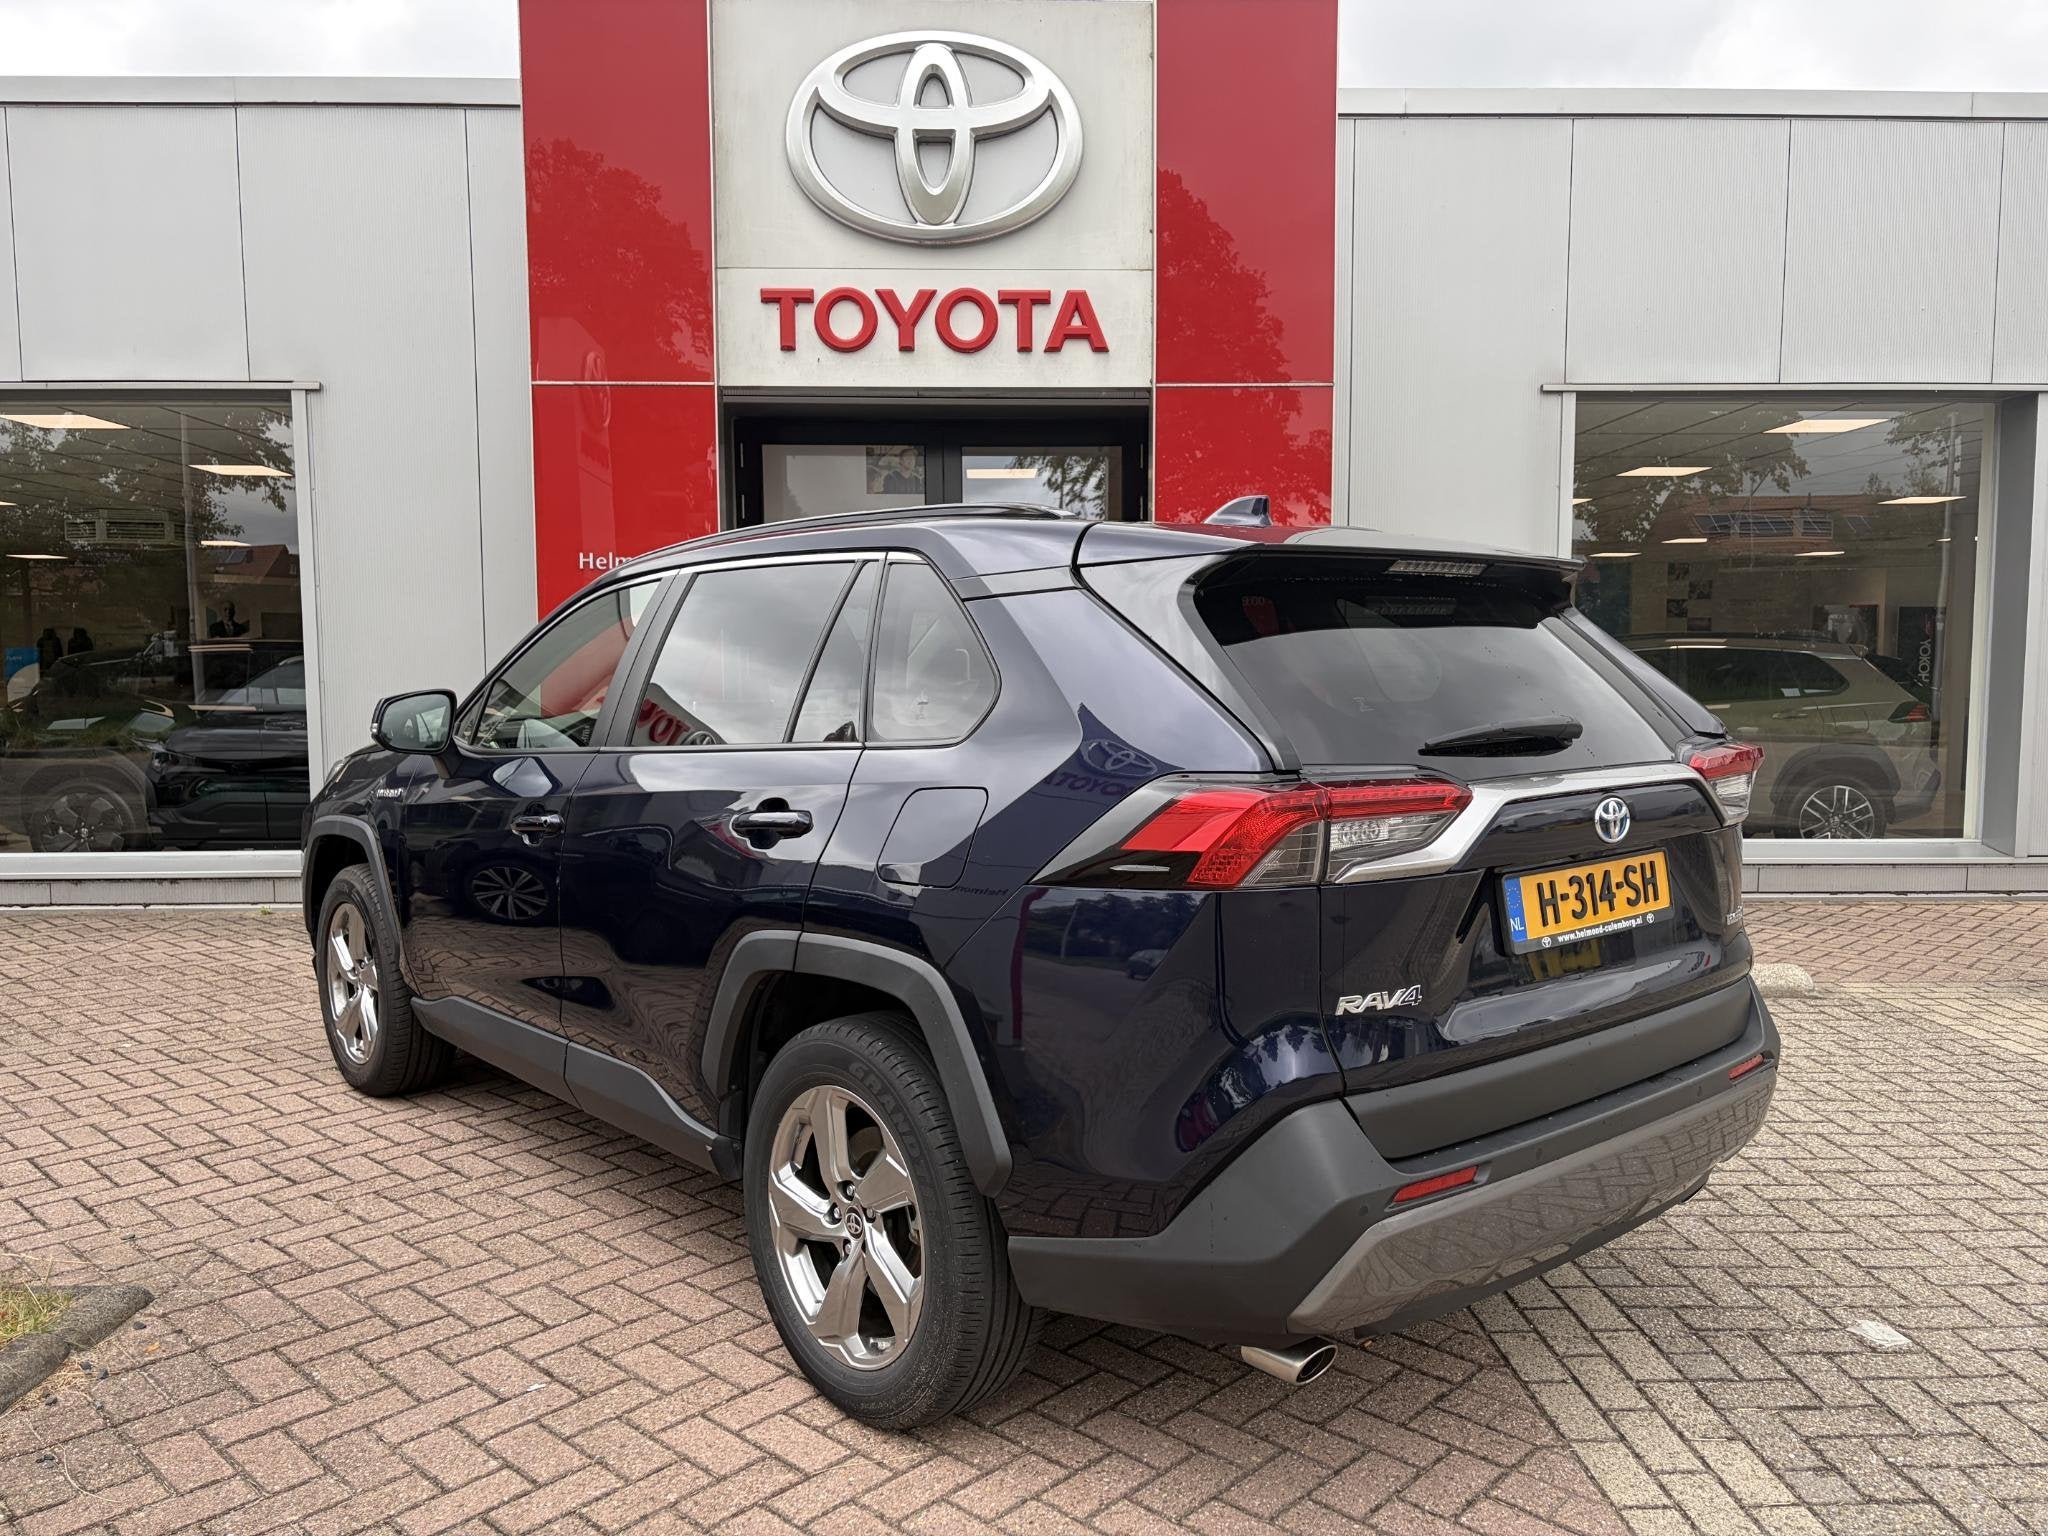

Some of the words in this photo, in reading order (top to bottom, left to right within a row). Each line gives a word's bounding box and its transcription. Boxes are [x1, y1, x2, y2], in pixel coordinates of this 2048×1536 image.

[760, 287, 1109, 353] TOYOTA
[1536, 860, 1660, 928] H-314-SH
[1509, 916, 1525, 932] NL
[1335, 984, 1423, 1016] RAV4
